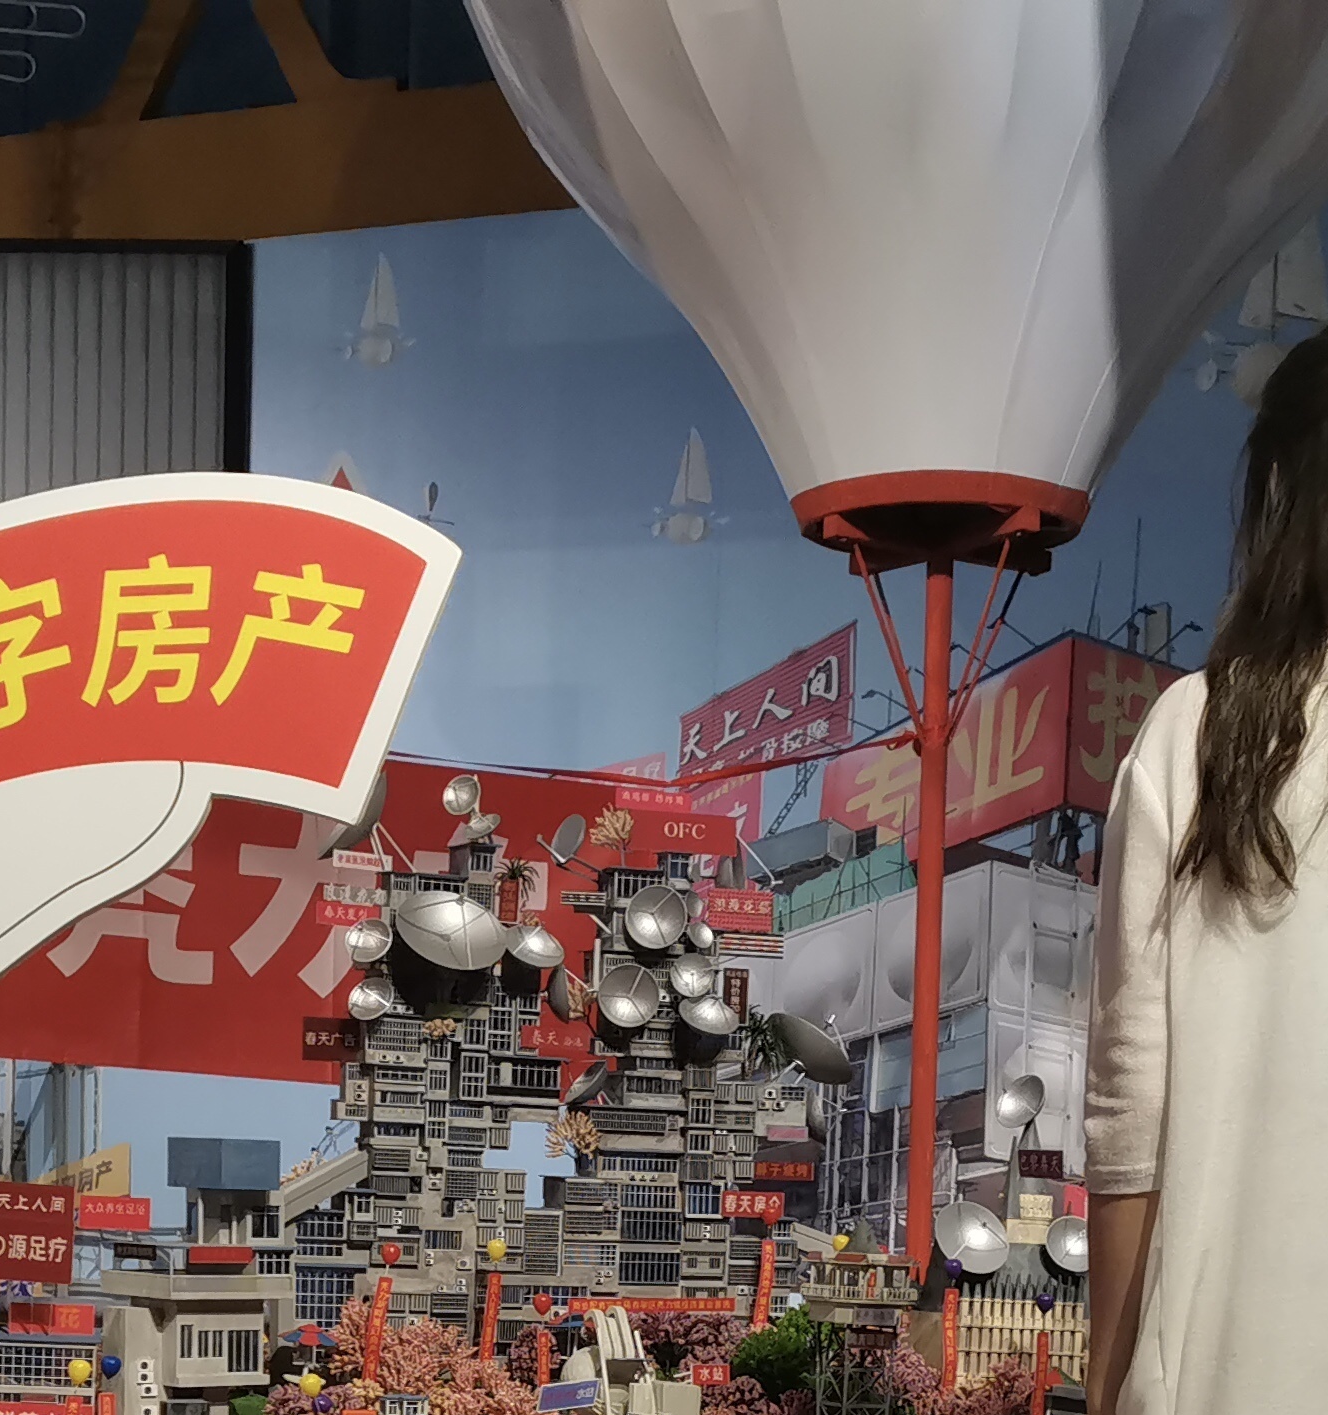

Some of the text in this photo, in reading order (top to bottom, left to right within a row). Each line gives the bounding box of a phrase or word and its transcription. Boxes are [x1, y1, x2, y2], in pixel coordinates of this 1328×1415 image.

[681, 655, 839, 766] 天上人间
[663, 820, 707, 840] OFC
[698, 1366, 725, 1382] 水站
